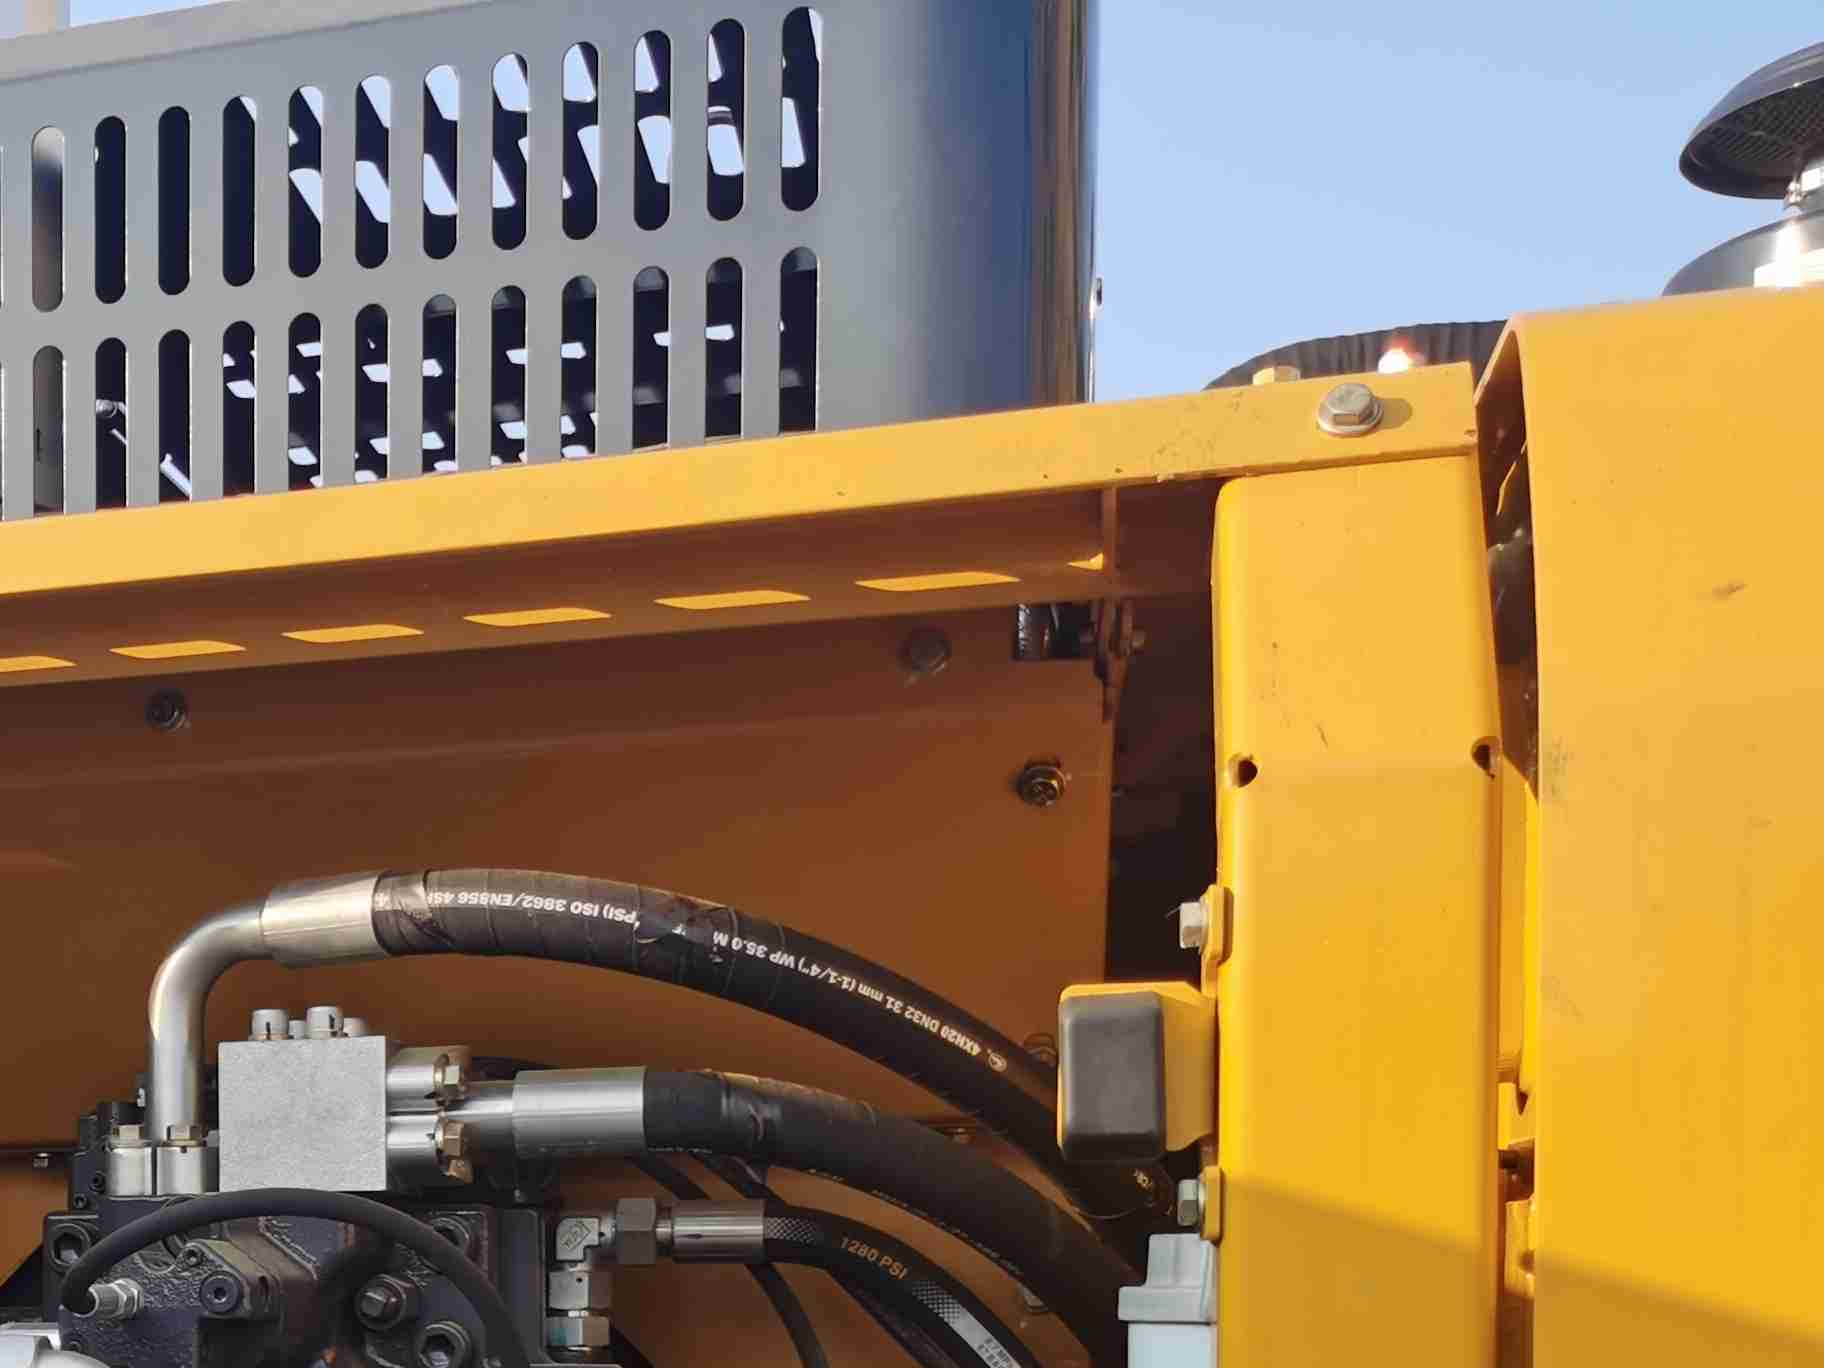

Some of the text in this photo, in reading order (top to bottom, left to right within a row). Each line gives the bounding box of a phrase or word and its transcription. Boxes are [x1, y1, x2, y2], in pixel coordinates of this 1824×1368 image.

[570, 900, 600, 915] ISO
[732, 937, 768, 958] 35.0
[769, 950, 796, 970] WP
[858, 984, 884, 1001] mm
[905, 1006, 940, 1032] DN32
[879, 1254, 908, 1280] PSI
